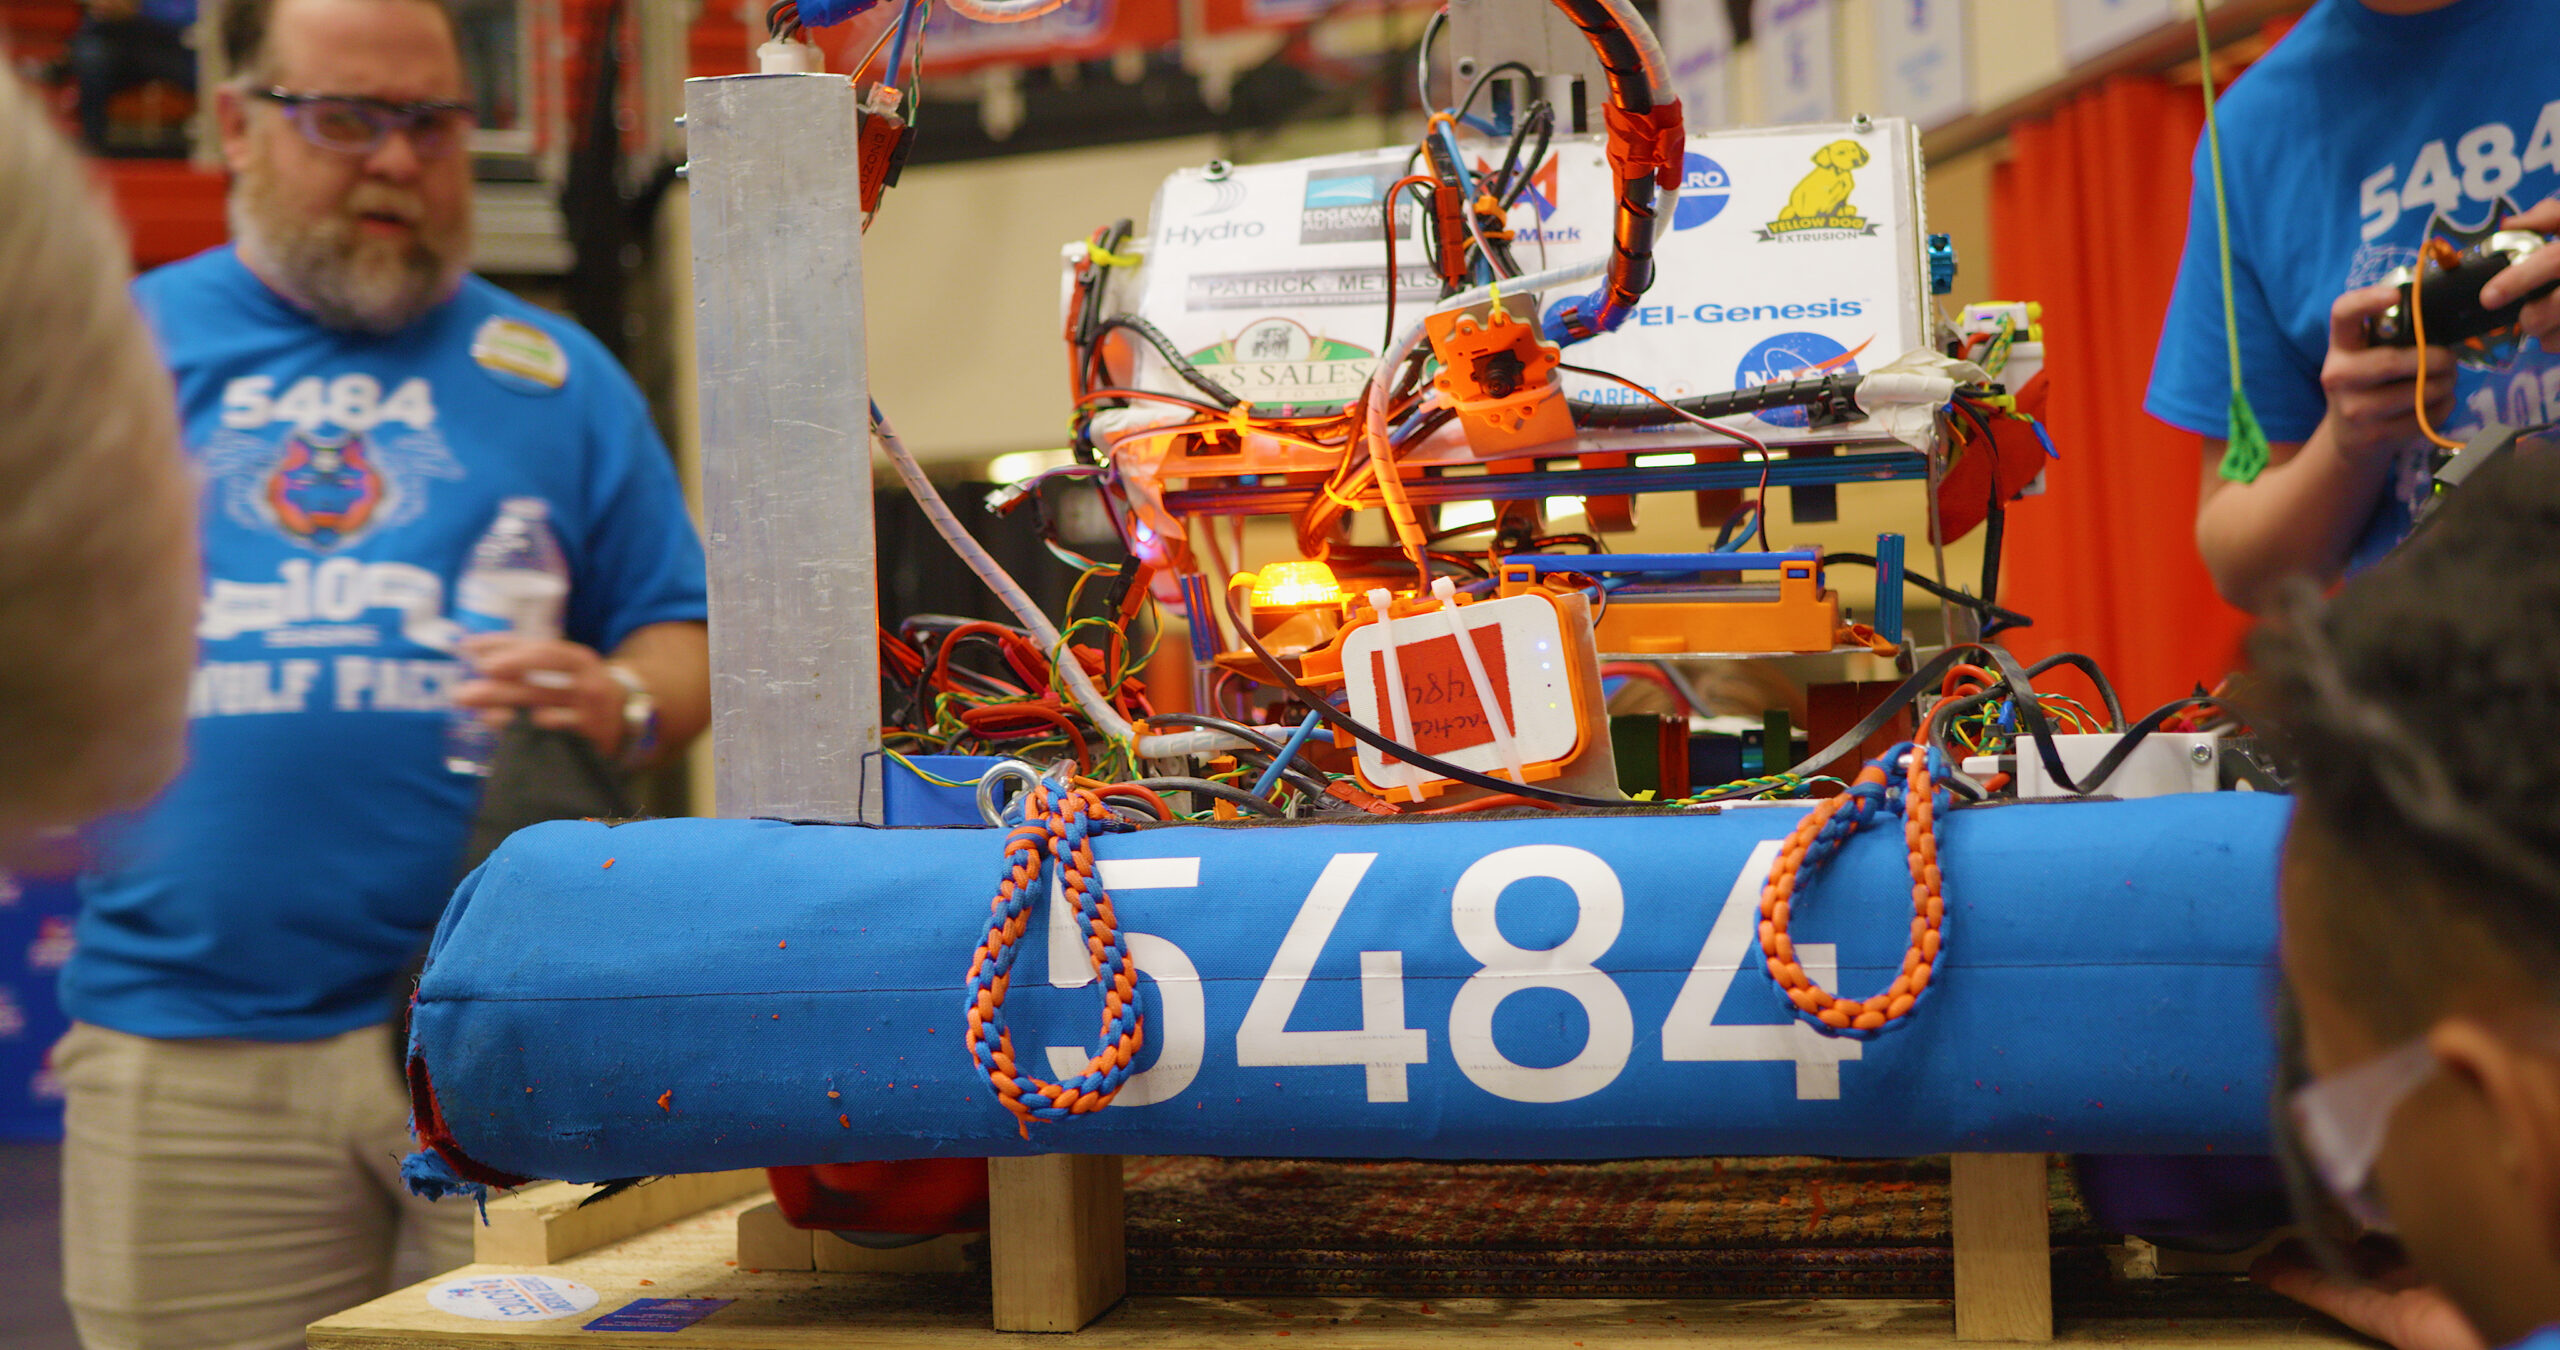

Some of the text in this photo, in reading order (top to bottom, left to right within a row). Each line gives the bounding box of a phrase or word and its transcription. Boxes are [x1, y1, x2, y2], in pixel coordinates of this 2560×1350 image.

[1681, 171, 1723, 188] RO
[2360, 98, 2560, 243] 5484
[1164, 219, 1265, 246] Hydro
[1515, 226, 1581, 242] Mark
[1768, 217, 1865, 233] YELLOW DOG
[1777, 231, 1858, 243] EXTRUSION
[1208, 275, 1317, 296] PATRICK
[1258, 362, 1367, 386] SALES
[221, 374, 437, 431] 5484
[1045, 838, 1863, 1106] 5484
